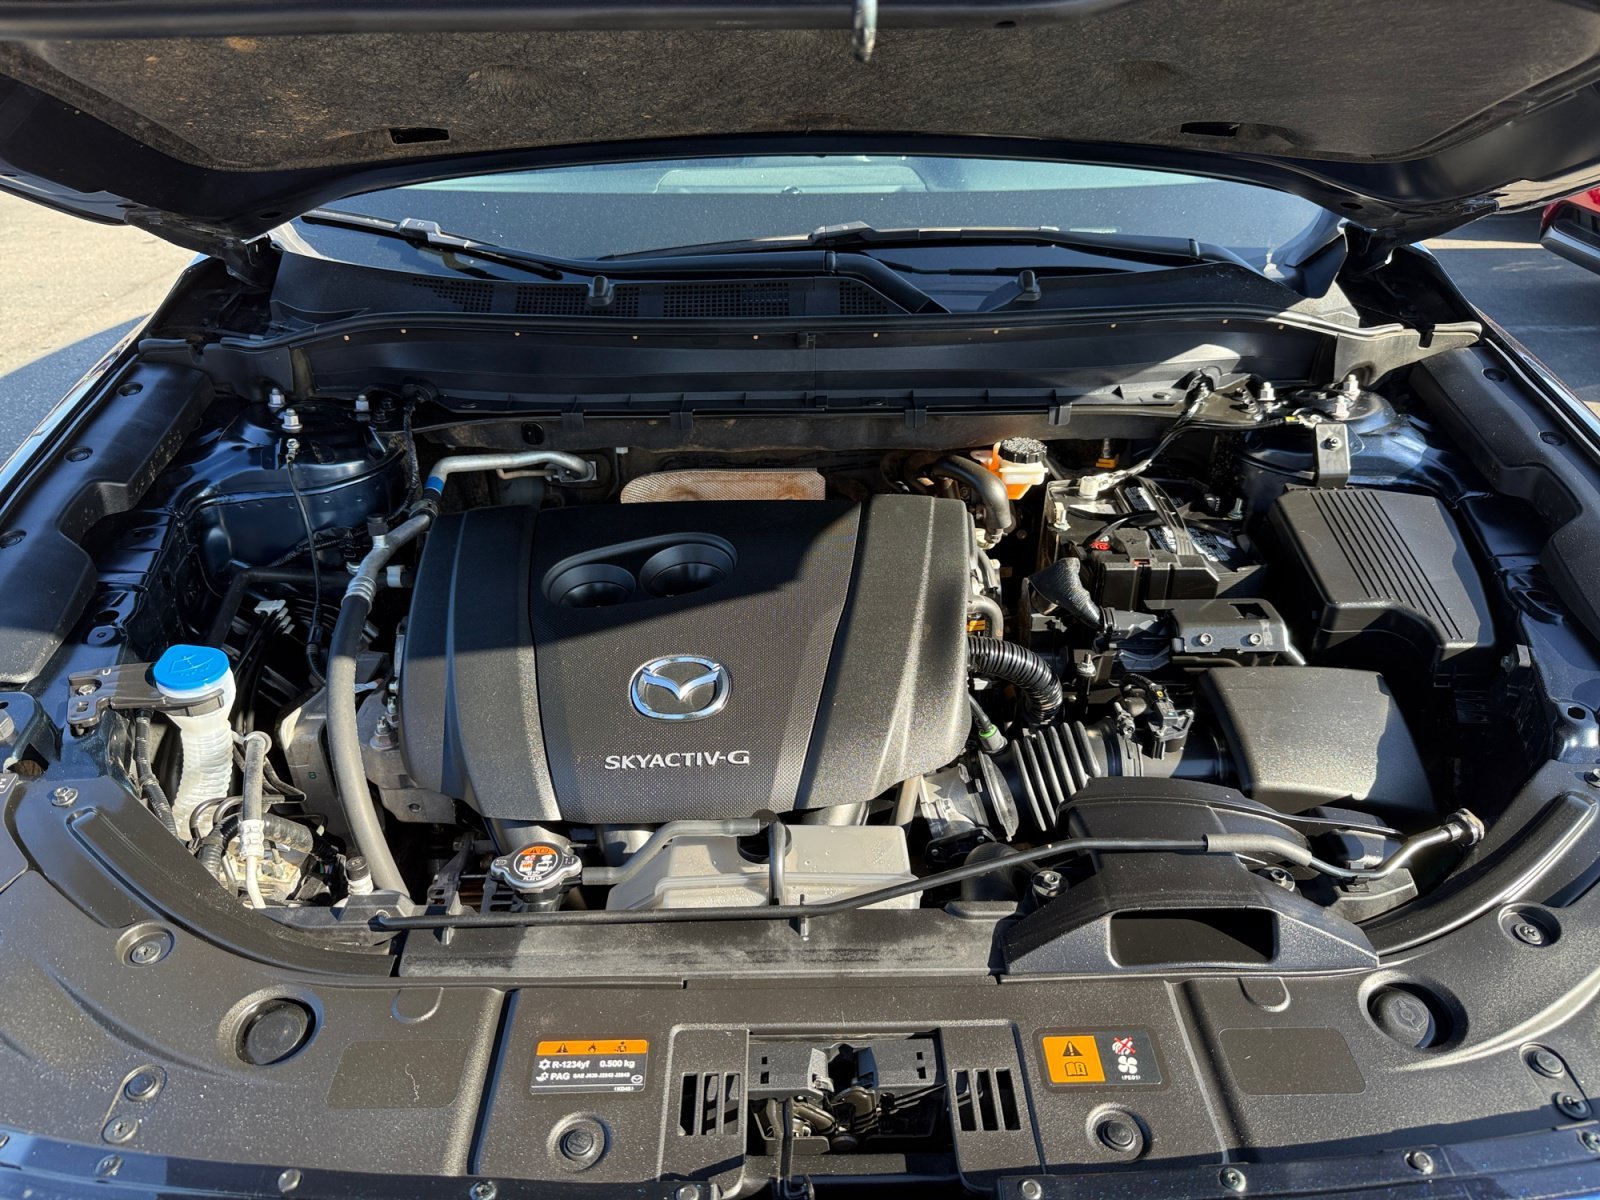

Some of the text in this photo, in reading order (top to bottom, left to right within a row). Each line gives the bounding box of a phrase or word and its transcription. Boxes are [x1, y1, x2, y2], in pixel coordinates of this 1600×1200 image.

[604, 750, 750, 770] SKYACTIV-G
[552, 1060, 635, 1069] R-1234yf 0.500 kg
